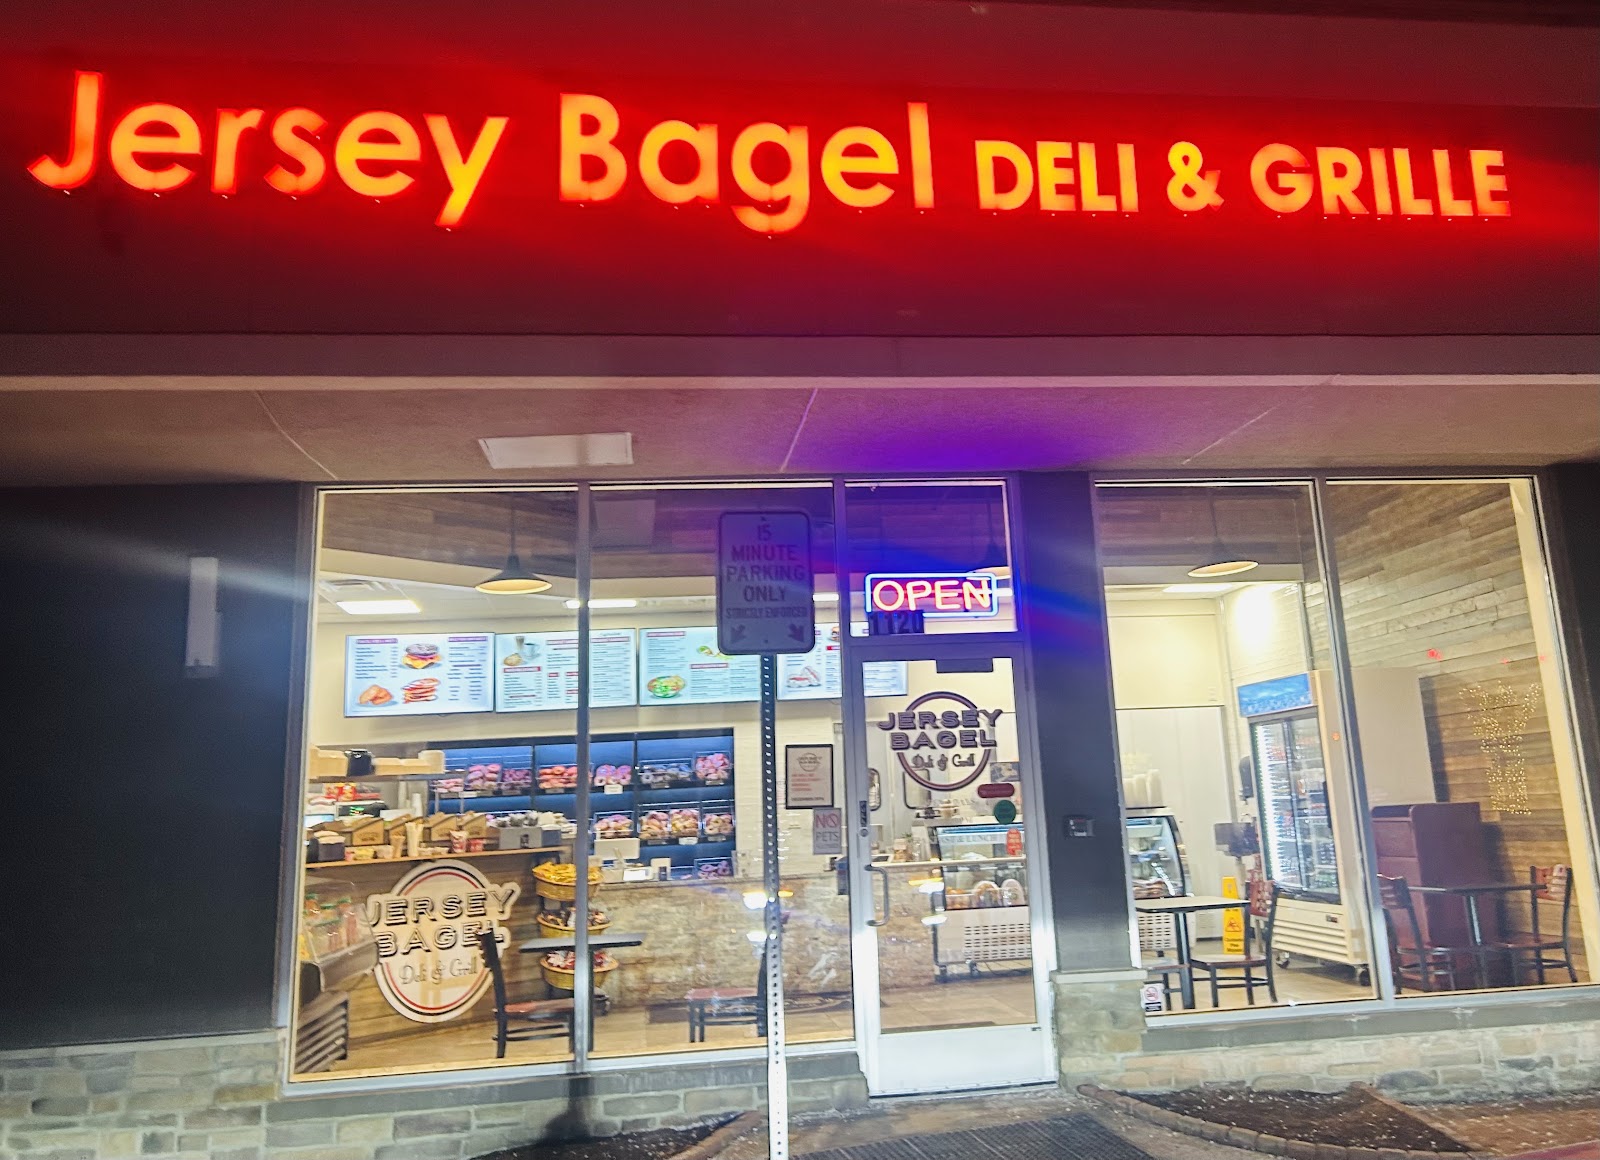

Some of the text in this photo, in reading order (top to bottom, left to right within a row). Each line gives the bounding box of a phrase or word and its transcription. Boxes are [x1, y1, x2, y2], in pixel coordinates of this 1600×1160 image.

[27, 70, 1512, 234] Jersey Bagel DELI & GRILLE
[757, 523, 772, 542] 15
[730, 544, 800, 561] MINUTE
[726, 565, 806, 582] PARKING
[743, 585, 787, 602] ONLY
[872, 579, 991, 612] OPEN
[878, 708, 1004, 731] JERSEY
[890, 729, 997, 751] BAGEL
[815, 812, 838, 829] NO
[815, 830, 840, 843] PETS
[360, 888, 516, 928] JERSEY
